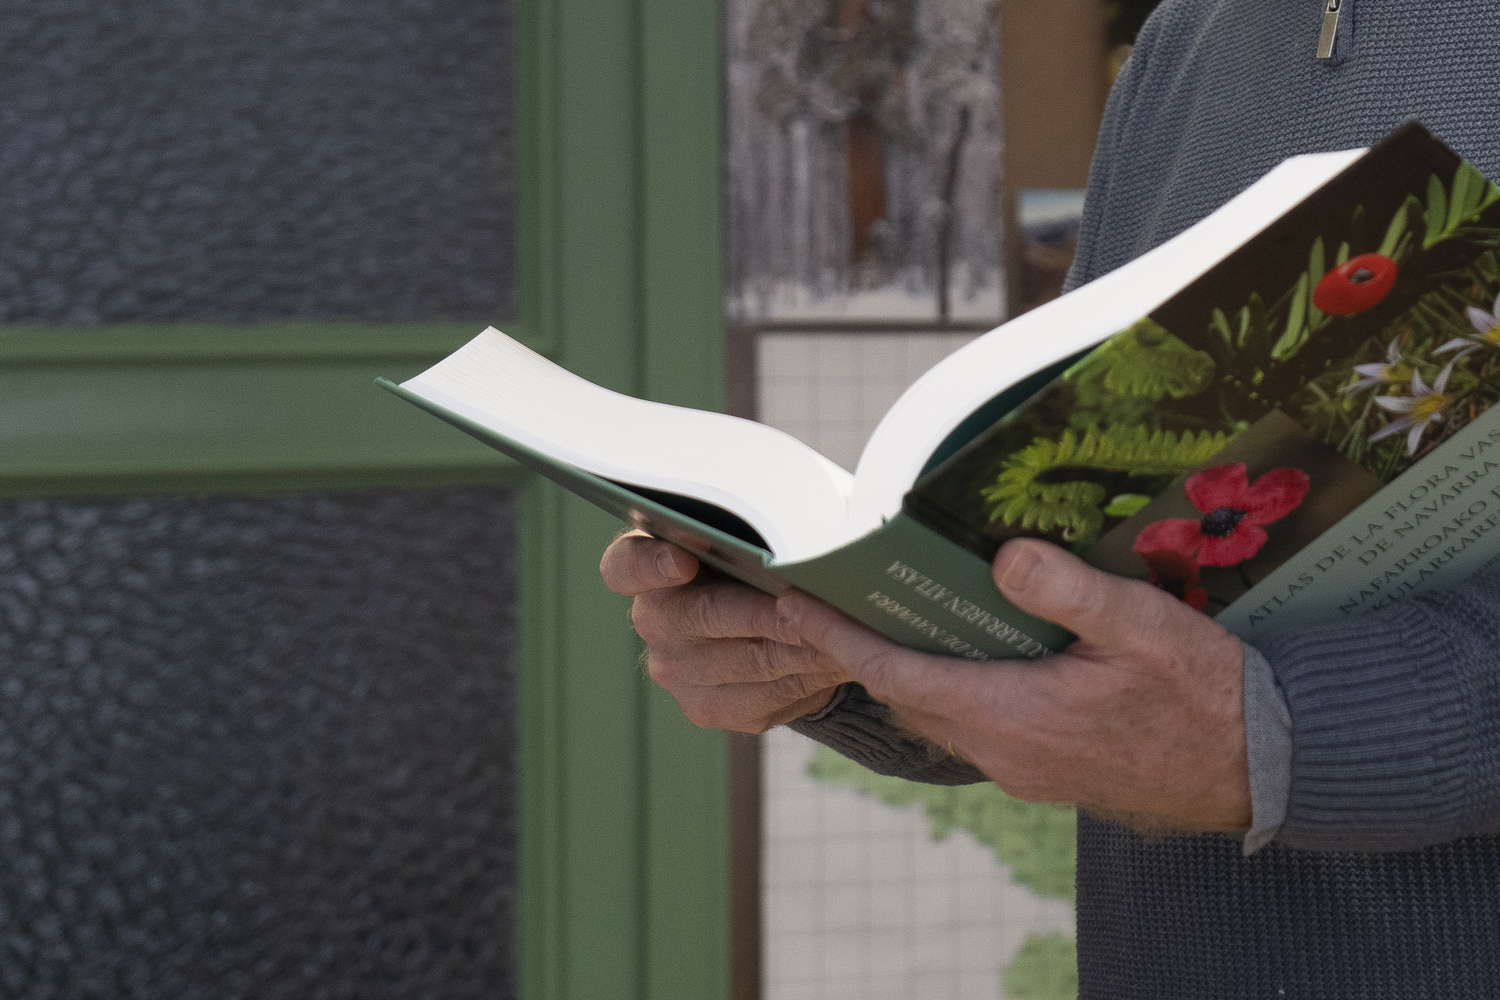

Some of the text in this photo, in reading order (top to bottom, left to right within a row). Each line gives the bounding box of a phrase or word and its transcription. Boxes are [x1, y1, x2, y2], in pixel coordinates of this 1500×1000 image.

[1249, 571, 1314, 626] ATLAS
[1315, 544, 1350, 573] DE
[1352, 522, 1383, 546] LA
[1384, 464, 1460, 521] FLORA
[1338, 500, 1487, 614] NAFARROAKO
[1357, 461, 1499, 566] DE NAVARRA
[867, 590, 972, 653] DE NAVARRA
[886, 560, 1053, 659] KULARRAREN ATLASA
